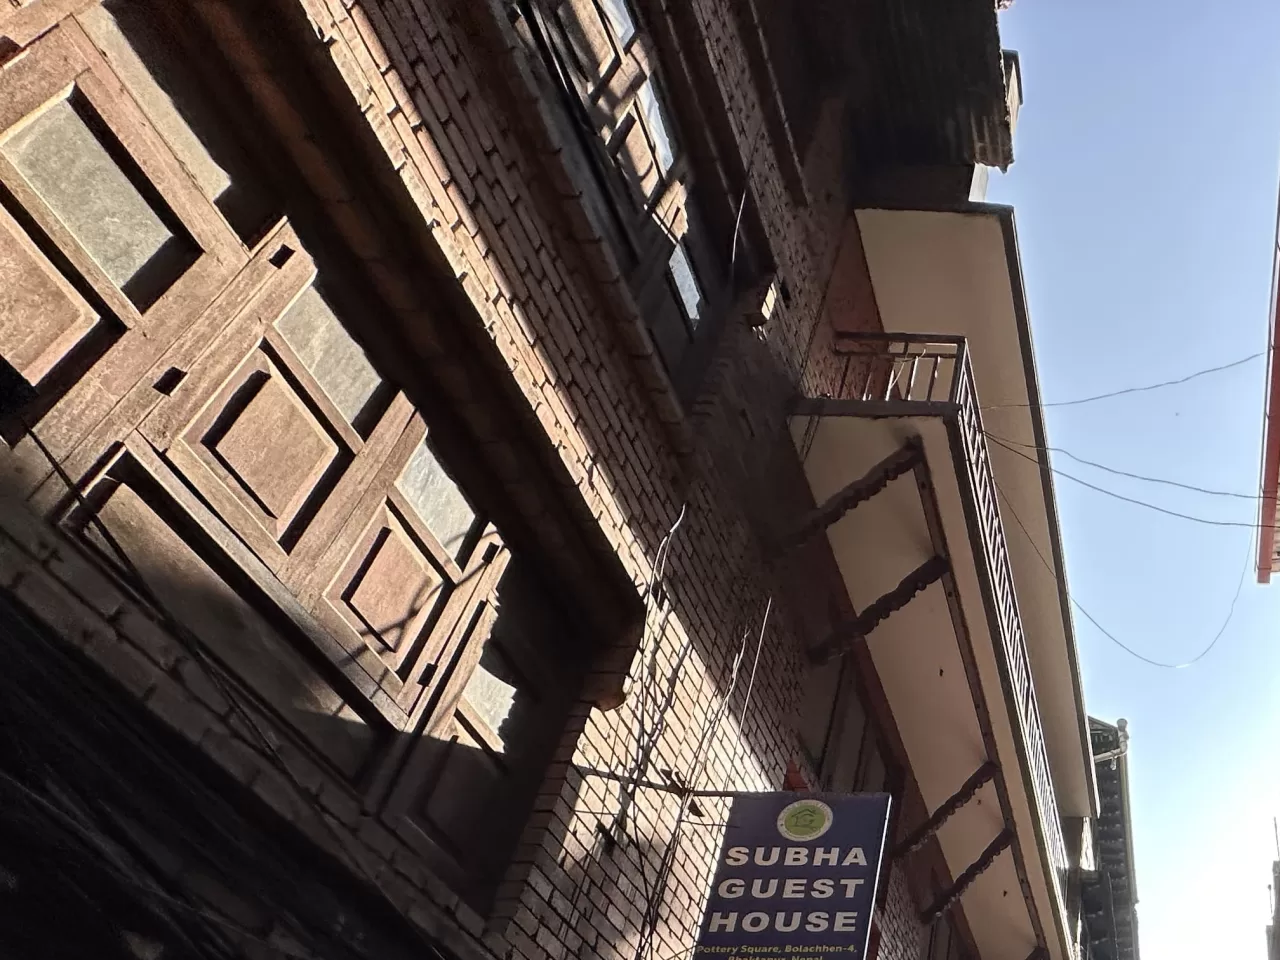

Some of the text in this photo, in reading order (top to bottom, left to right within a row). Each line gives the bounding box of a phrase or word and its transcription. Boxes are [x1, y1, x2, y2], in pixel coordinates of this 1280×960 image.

[725, 846, 868, 866] SUBHA
[717, 878, 865, 899] GUEST
[708, 911, 859, 933] HOUSE
[696, 945, 738, 955] Pottery
[740, 944, 782, 954] Square,
